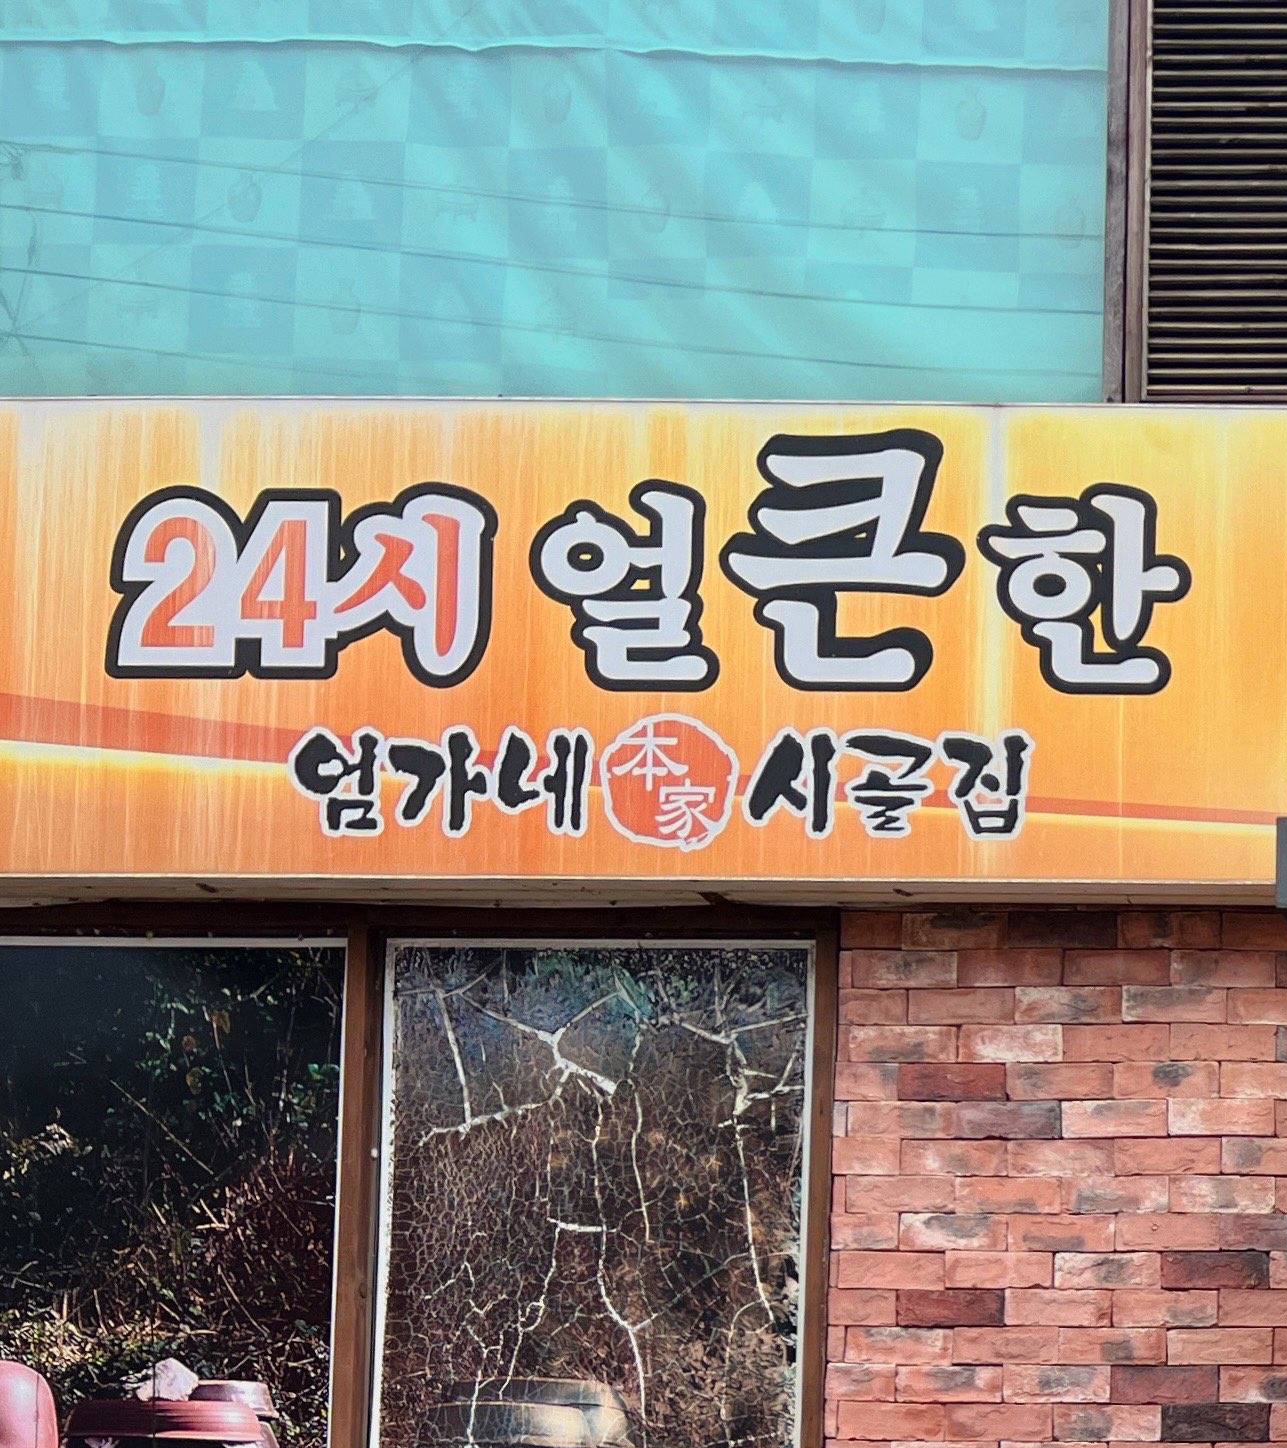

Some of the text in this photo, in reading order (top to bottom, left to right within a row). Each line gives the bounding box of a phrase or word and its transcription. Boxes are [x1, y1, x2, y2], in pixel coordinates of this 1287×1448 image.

[107, 482, 498, 688] 24시
[531, 428, 1190, 697] 얼큰한
[292, 725, 591, 837] 엄가네
[748, 725, 1034, 842] 시골집
